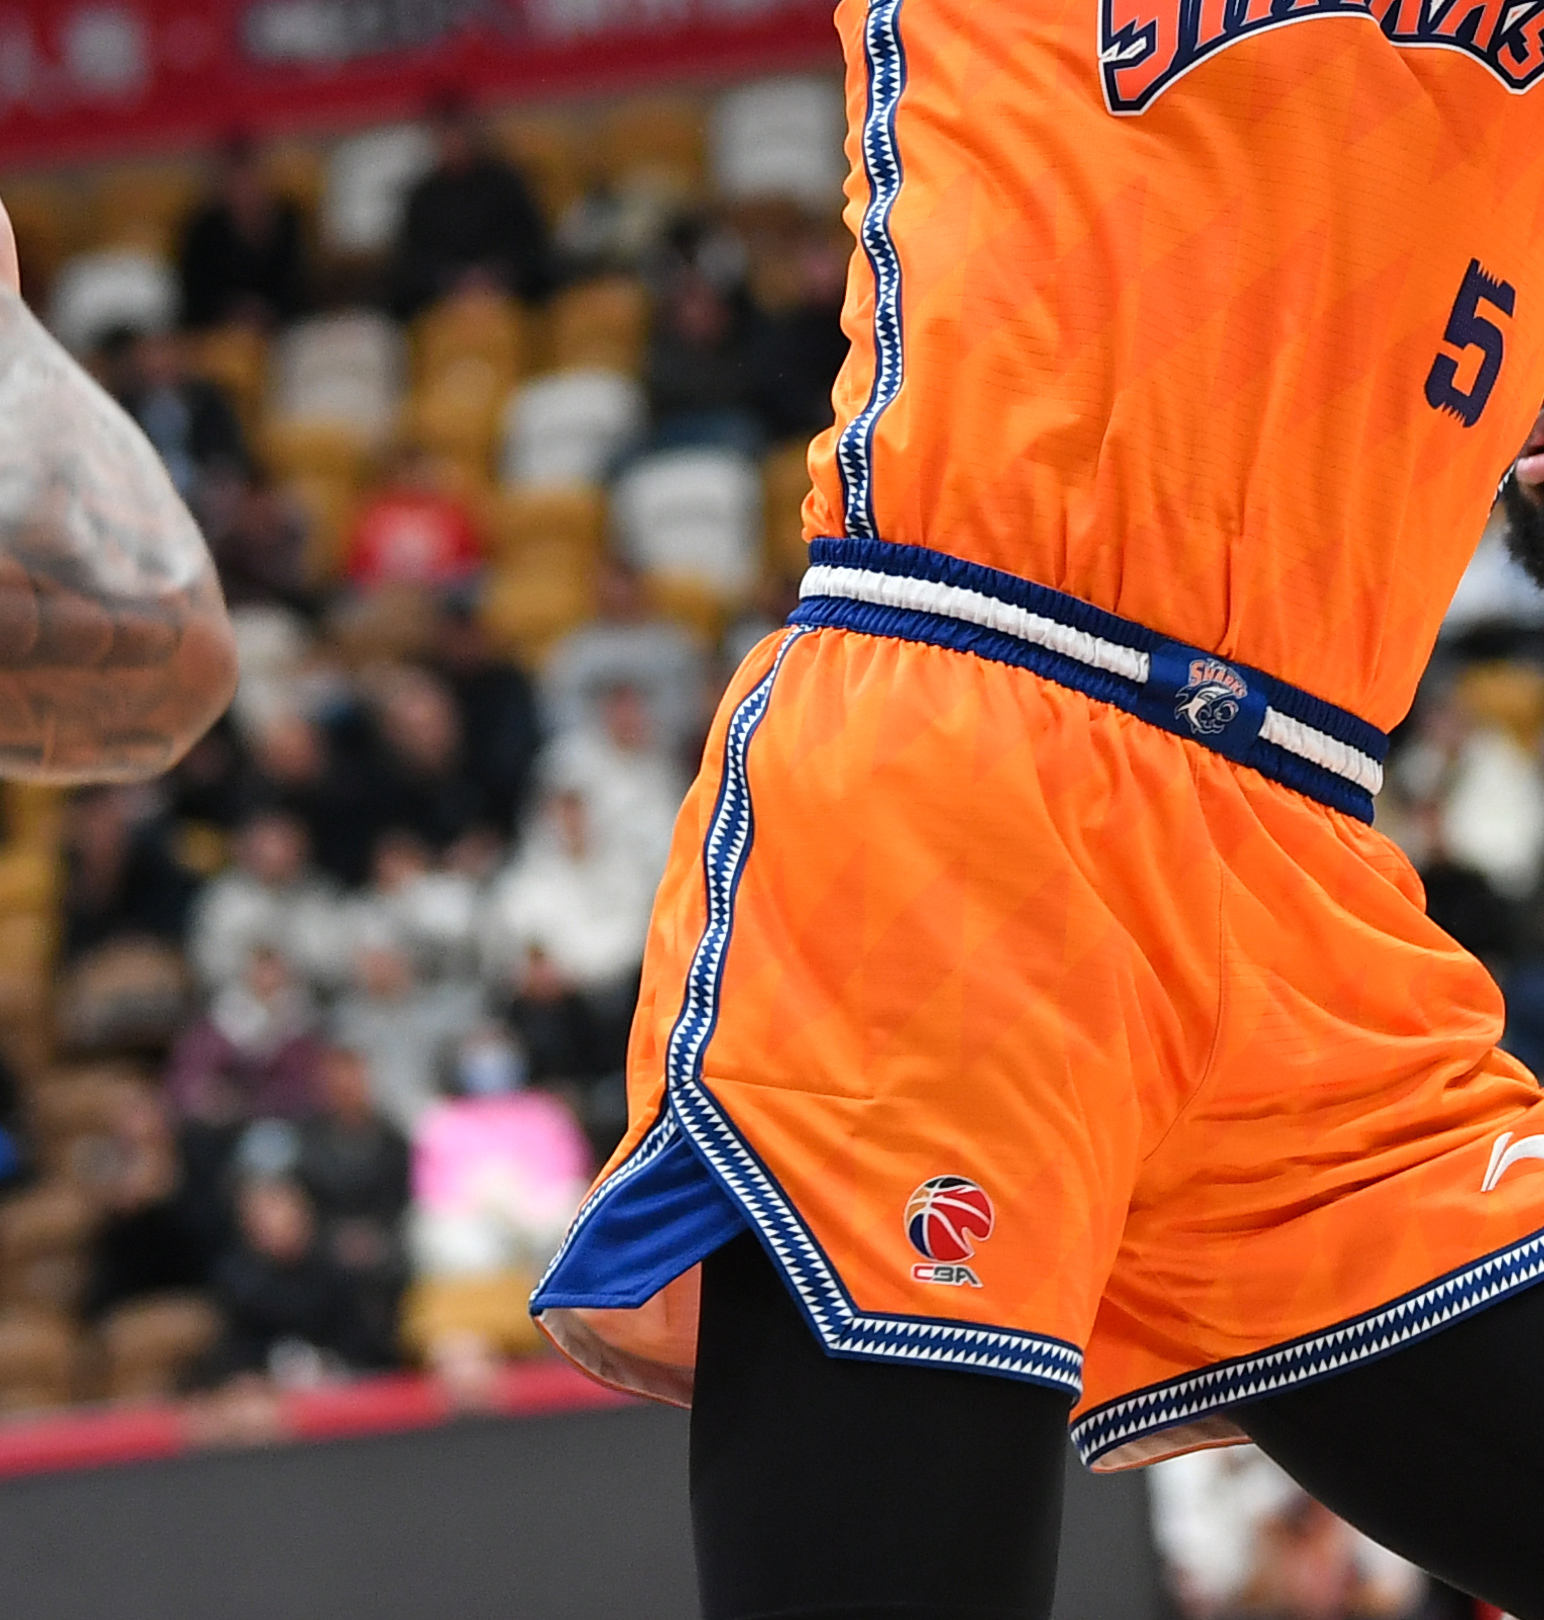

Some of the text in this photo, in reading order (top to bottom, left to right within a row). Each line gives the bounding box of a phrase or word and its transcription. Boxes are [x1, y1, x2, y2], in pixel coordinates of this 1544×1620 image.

[1424, 257, 1516, 428] 5
[1188, 658, 1248, 699] SHARKS
[911, 1264, 983, 1288] CBA
